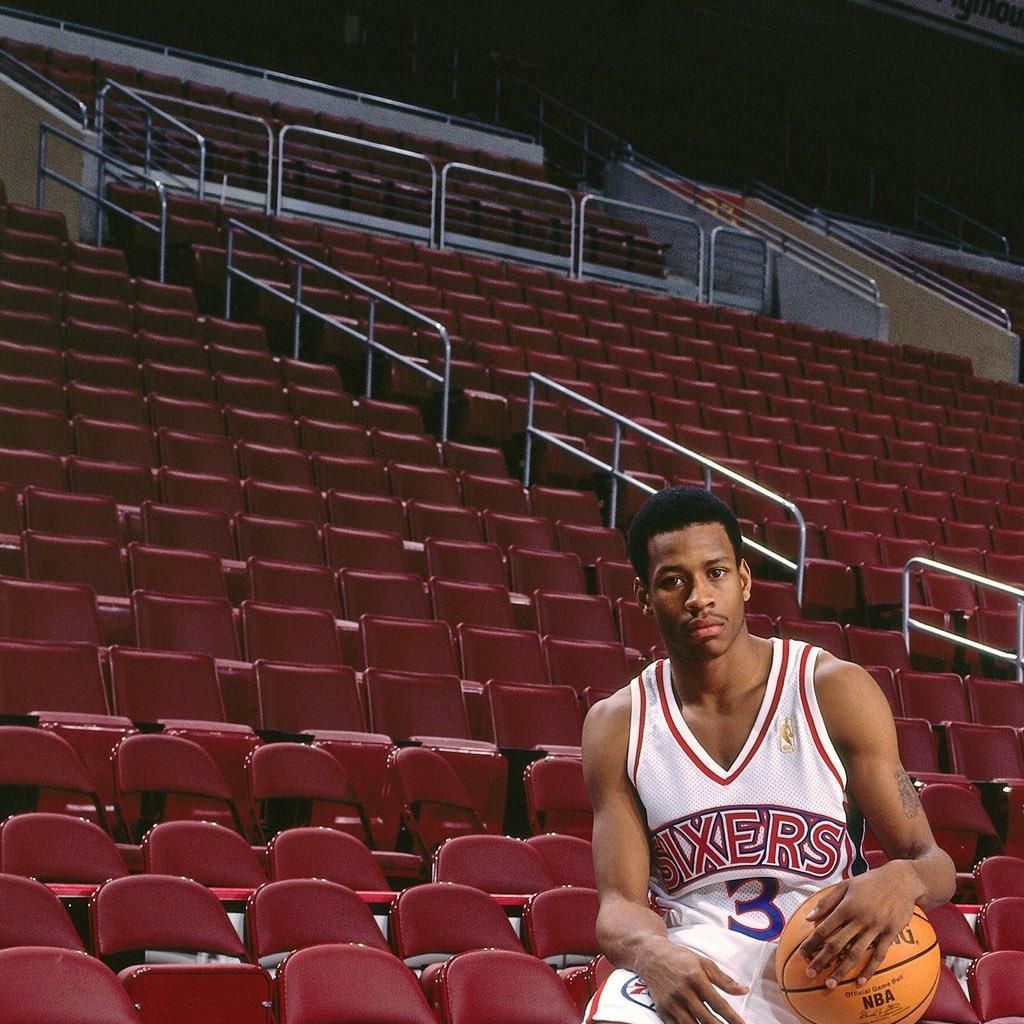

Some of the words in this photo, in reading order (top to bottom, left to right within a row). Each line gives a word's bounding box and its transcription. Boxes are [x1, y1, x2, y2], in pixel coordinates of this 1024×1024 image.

[653, 809, 845, 891] SIXERS
[726, 877, 786, 942] 3
[862, 989, 895, 1010] NBA
